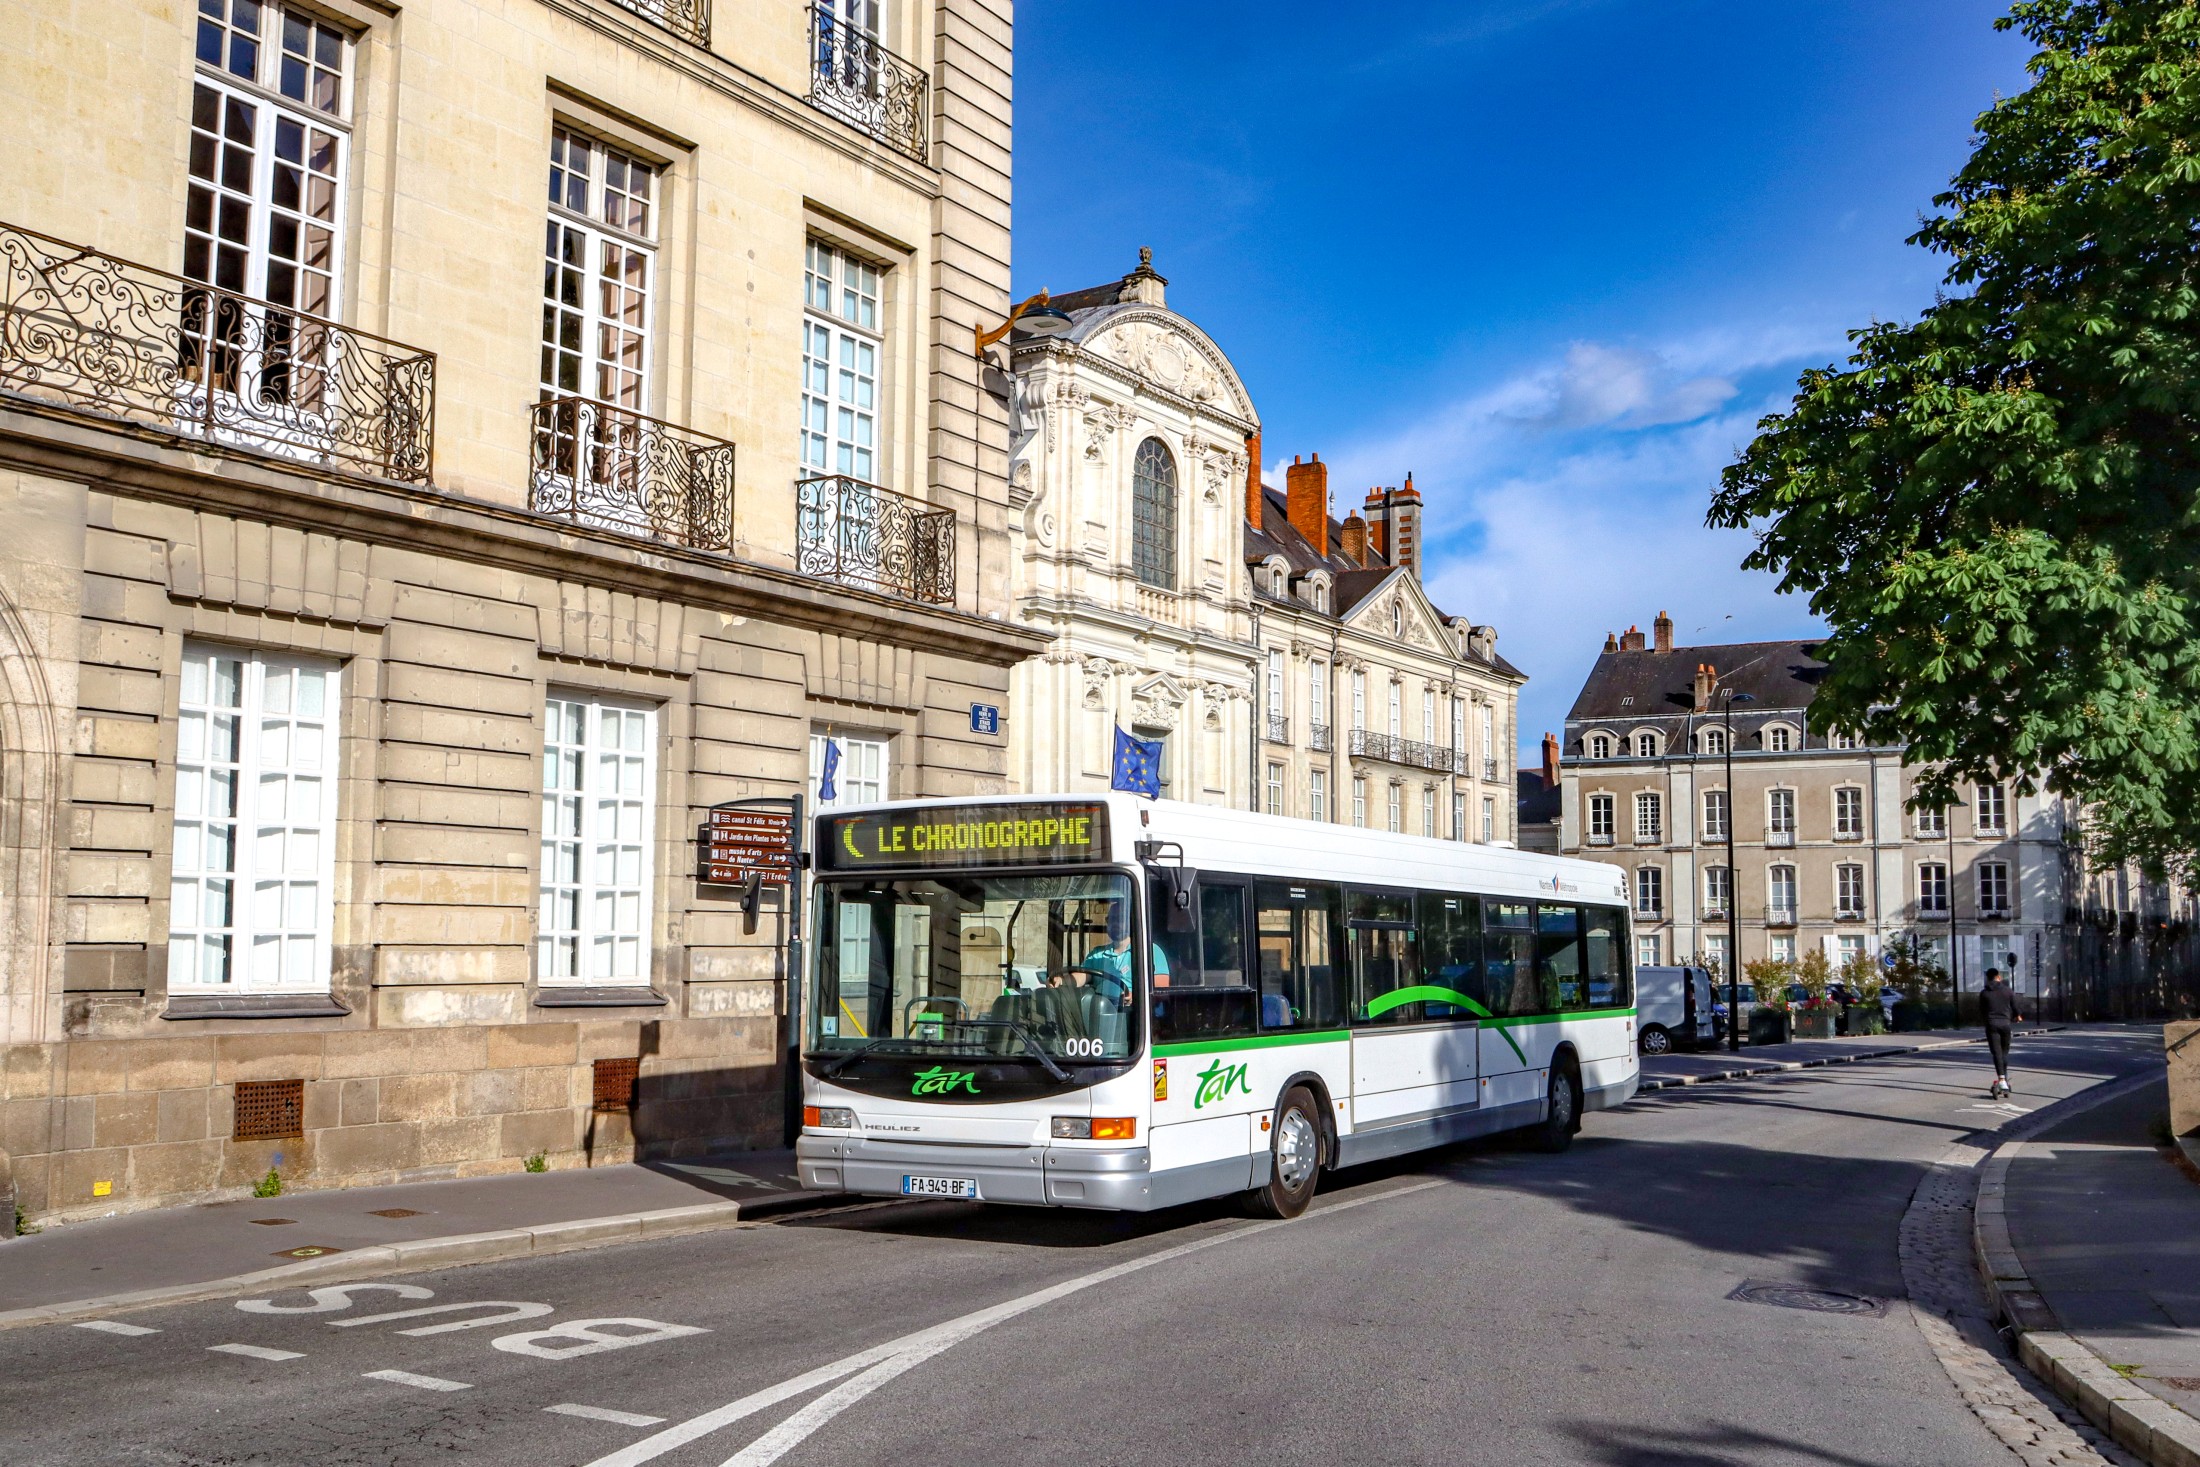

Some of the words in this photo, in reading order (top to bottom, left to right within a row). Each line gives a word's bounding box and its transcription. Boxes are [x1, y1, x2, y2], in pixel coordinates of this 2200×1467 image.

[753, 817, 765, 825] Félix
[744, 833, 752, 841] des
[753, 834, 769, 842] Plantes
[878, 826, 906, 852] LE
[912, 817, 1090, 850] CHRONOGRAPHE
[728, 855, 736, 863] de
[747, 848, 762, 856] d'arts
[1066, 1038, 1104, 1057] 006
[911, 1065, 981, 1095] tan
[1194, 1058, 1252, 1110] tan
[864, 1124, 921, 1132] HEULIEZ
[234, 1283, 715, 1361] BUS
